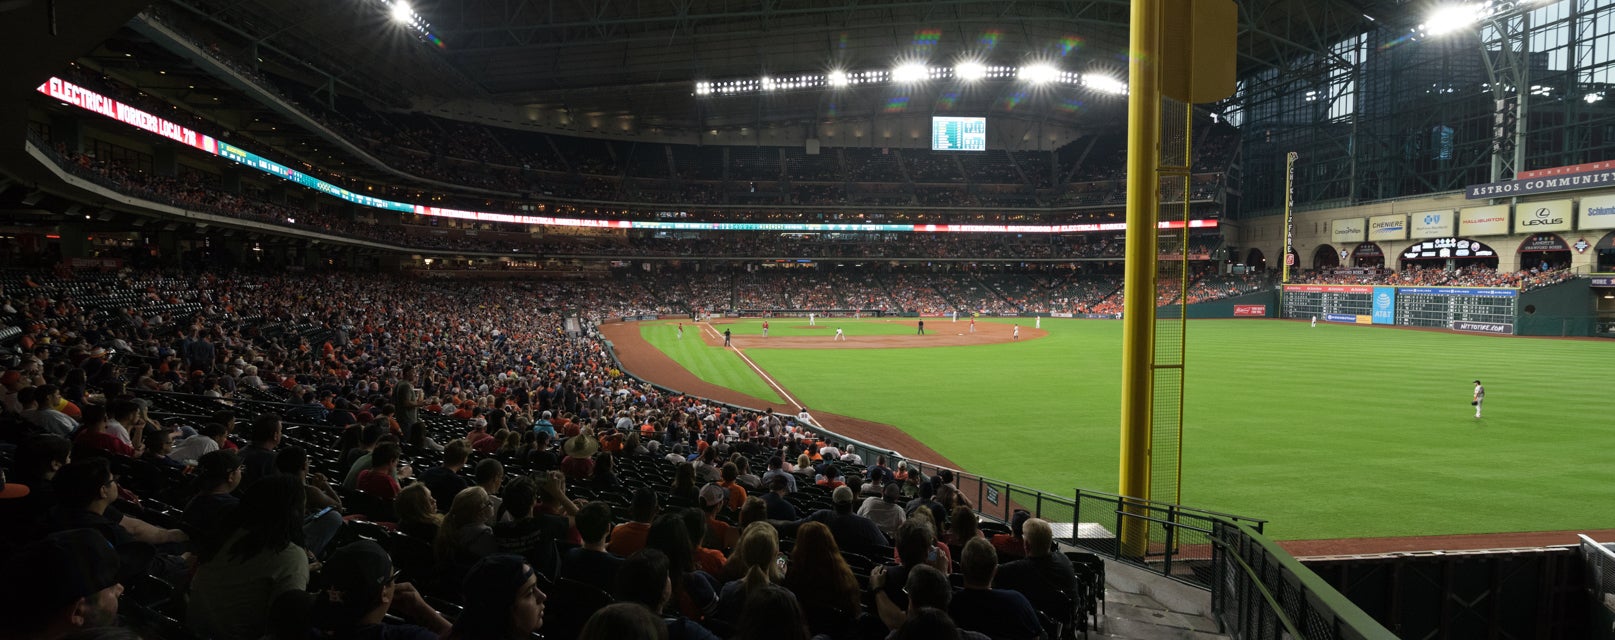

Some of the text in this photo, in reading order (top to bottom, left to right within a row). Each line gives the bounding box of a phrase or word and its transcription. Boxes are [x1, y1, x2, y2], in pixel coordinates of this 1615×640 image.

[50, 77, 115, 118] ELECTRICAL
[116, 102, 158, 132] WORKERS
[159, 118, 182, 141] LOCAL
[1529, 166, 1580, 177] MINUTE
[1472, 183, 1520, 196] ASTROS
[1372, 220, 1404, 229] CHENIERE
[1522, 218, 1563, 226] LEXUS
